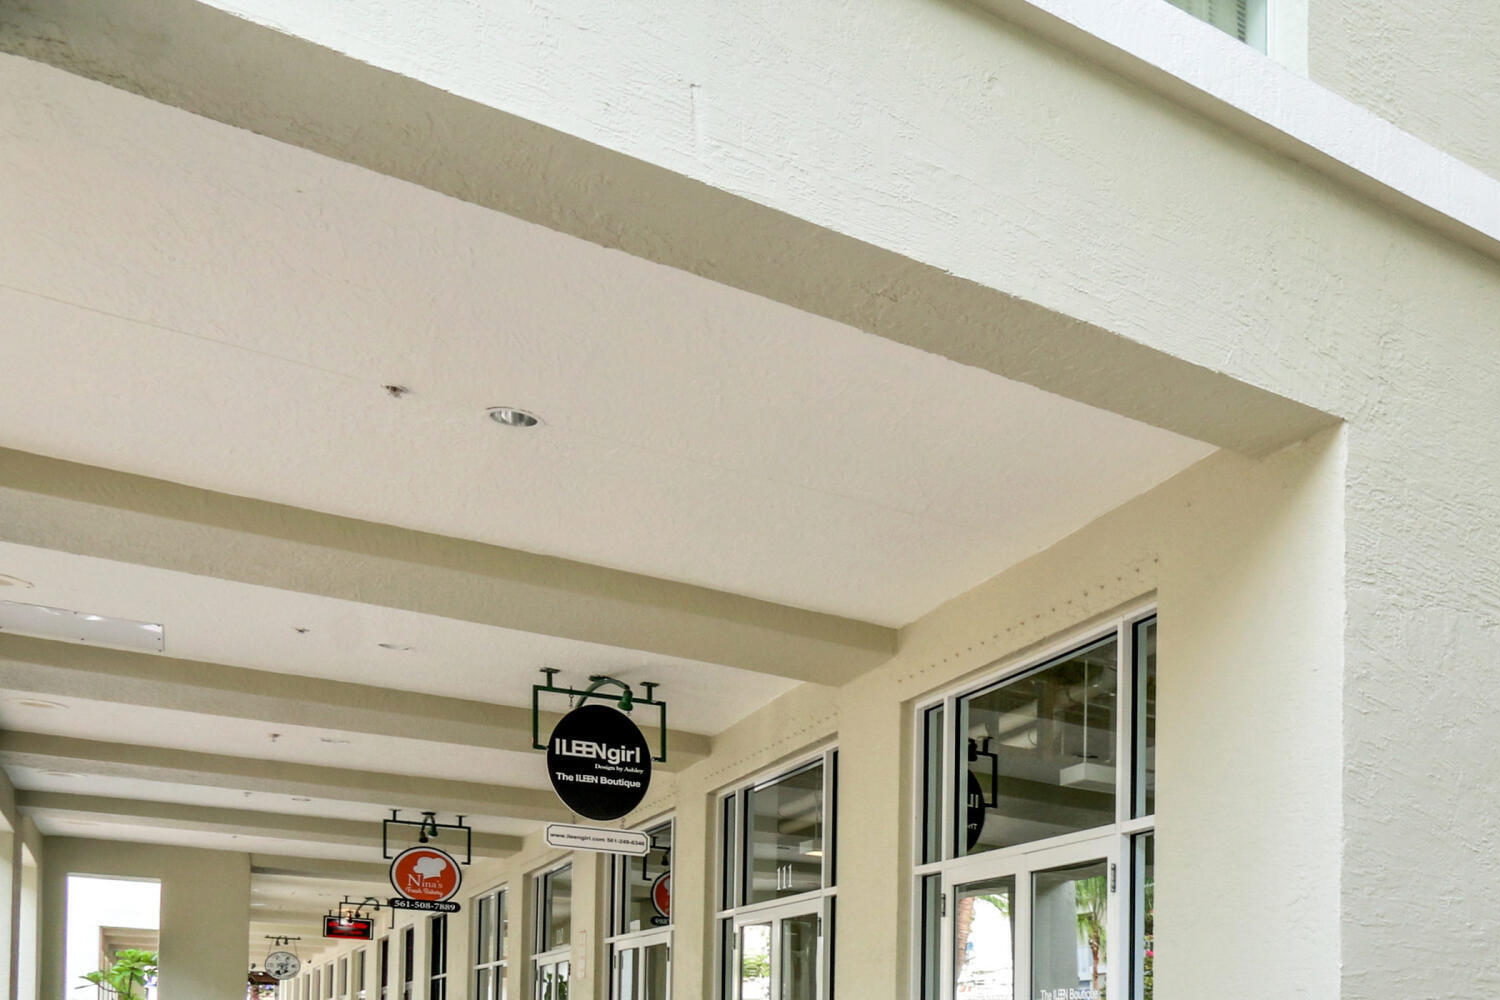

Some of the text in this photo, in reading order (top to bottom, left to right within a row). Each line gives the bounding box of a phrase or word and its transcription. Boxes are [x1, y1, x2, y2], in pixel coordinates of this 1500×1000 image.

[554, 737, 641, 765] ILEENgirl
[594, 763, 616, 771] Design
[624, 766, 645, 775] Ashley
[555, 771, 641, 788] The ILEEN Boutique
[407, 873, 443, 889] Nina's
[776, 864, 792, 890] 111
[393, 900, 456, 911] 561-508-7889
[1040, 989, 1052, 1000] The
